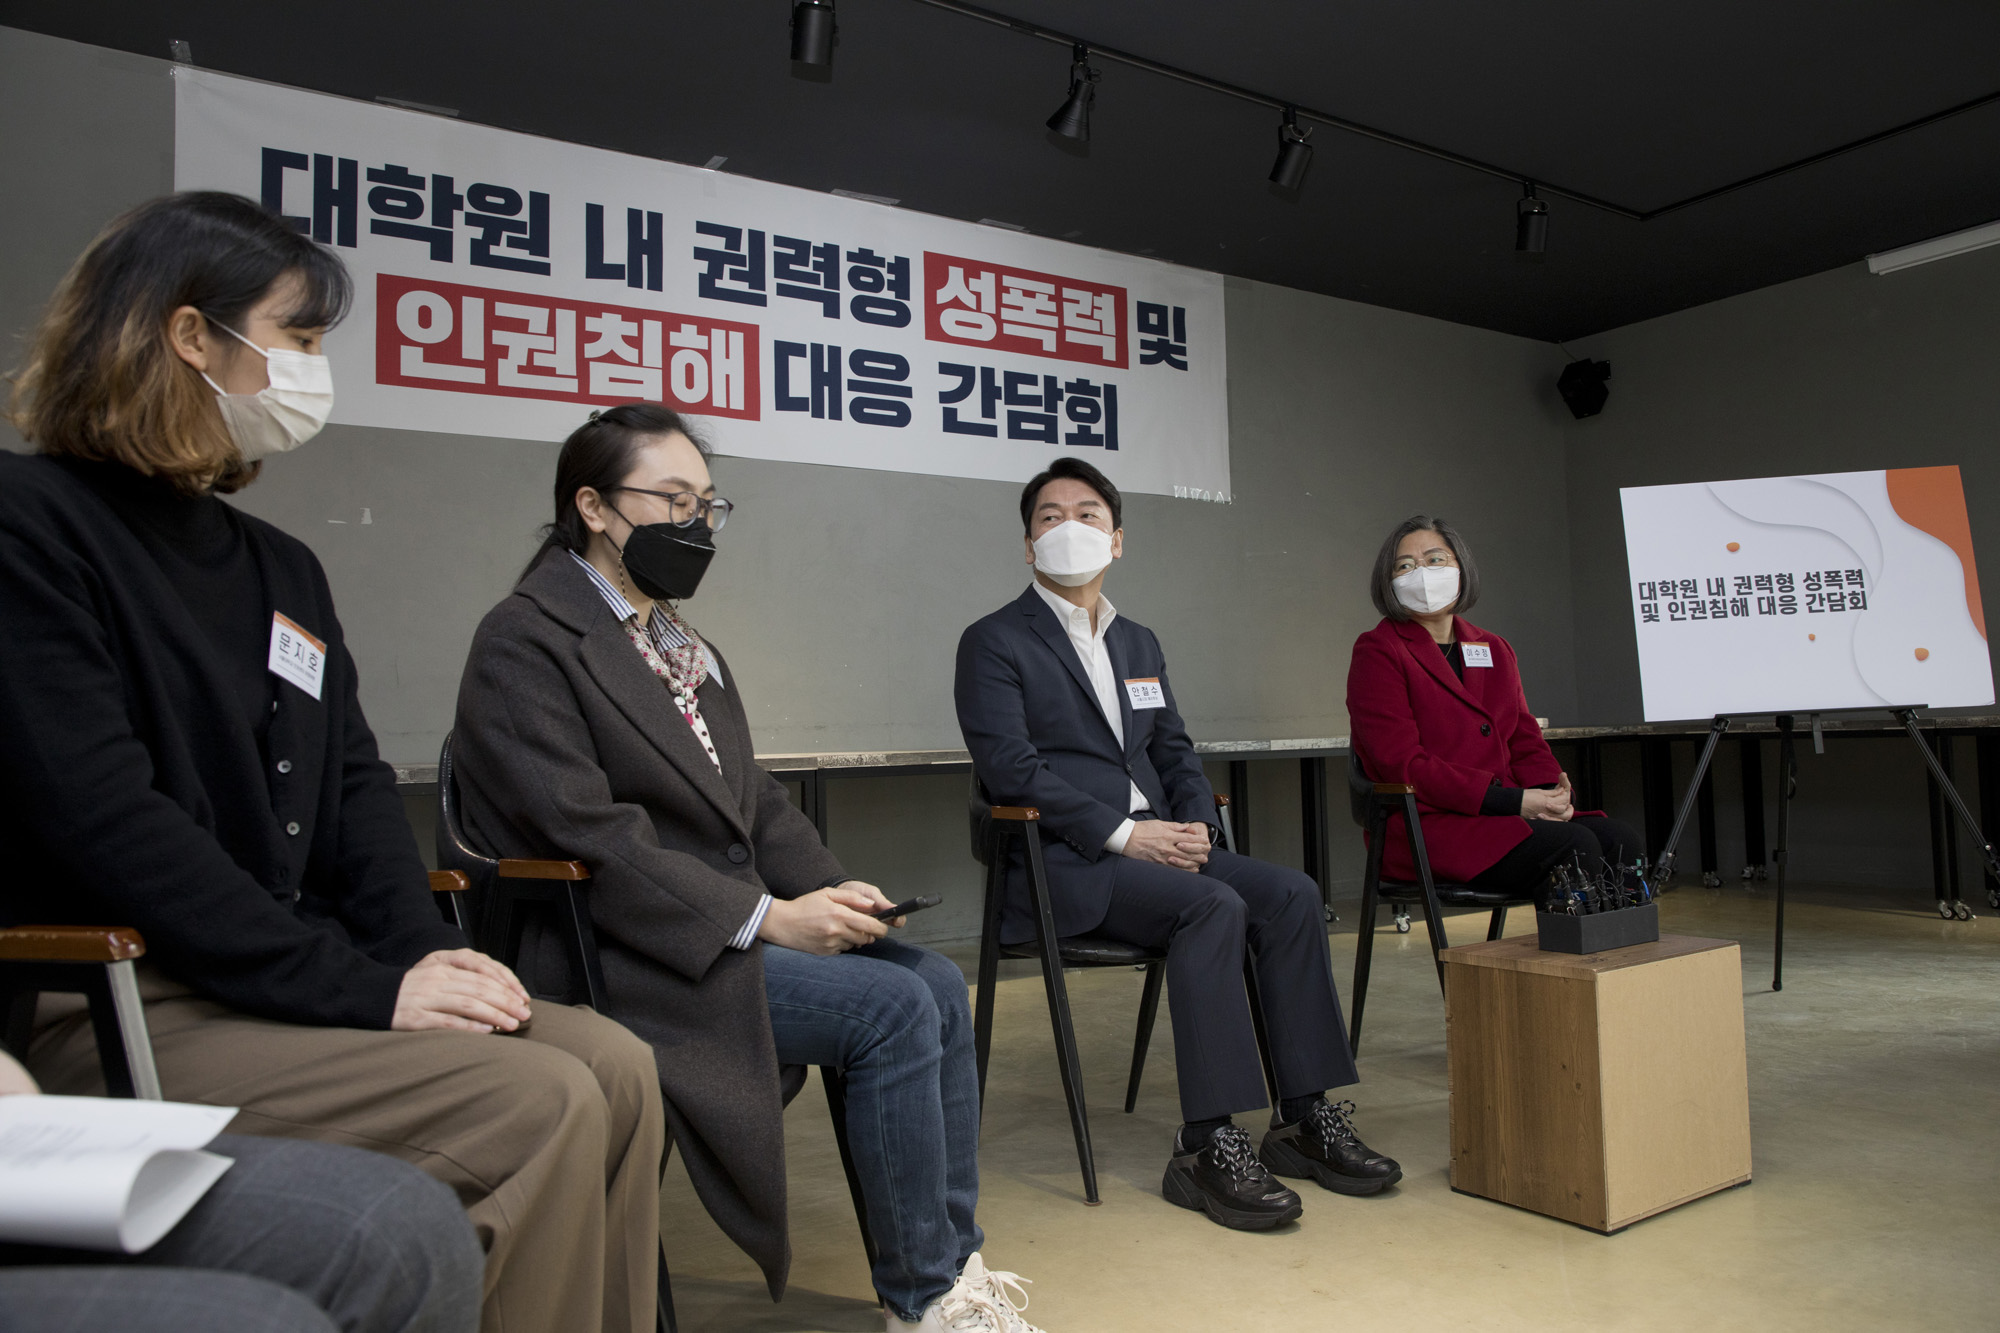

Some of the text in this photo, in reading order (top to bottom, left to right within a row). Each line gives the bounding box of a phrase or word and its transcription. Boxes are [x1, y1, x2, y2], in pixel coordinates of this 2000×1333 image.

[261, 147, 1188, 371] 대학원 내 권력형 성폭력 및
[396, 290, 1119, 451] 인권침해 대응 간담회
[1638, 569, 1865, 601] 대학원 내 권력형 성폭력
[1640, 590, 1868, 623] 및 인권침해 대응 간담회
[279, 632, 319, 673] 문지호
